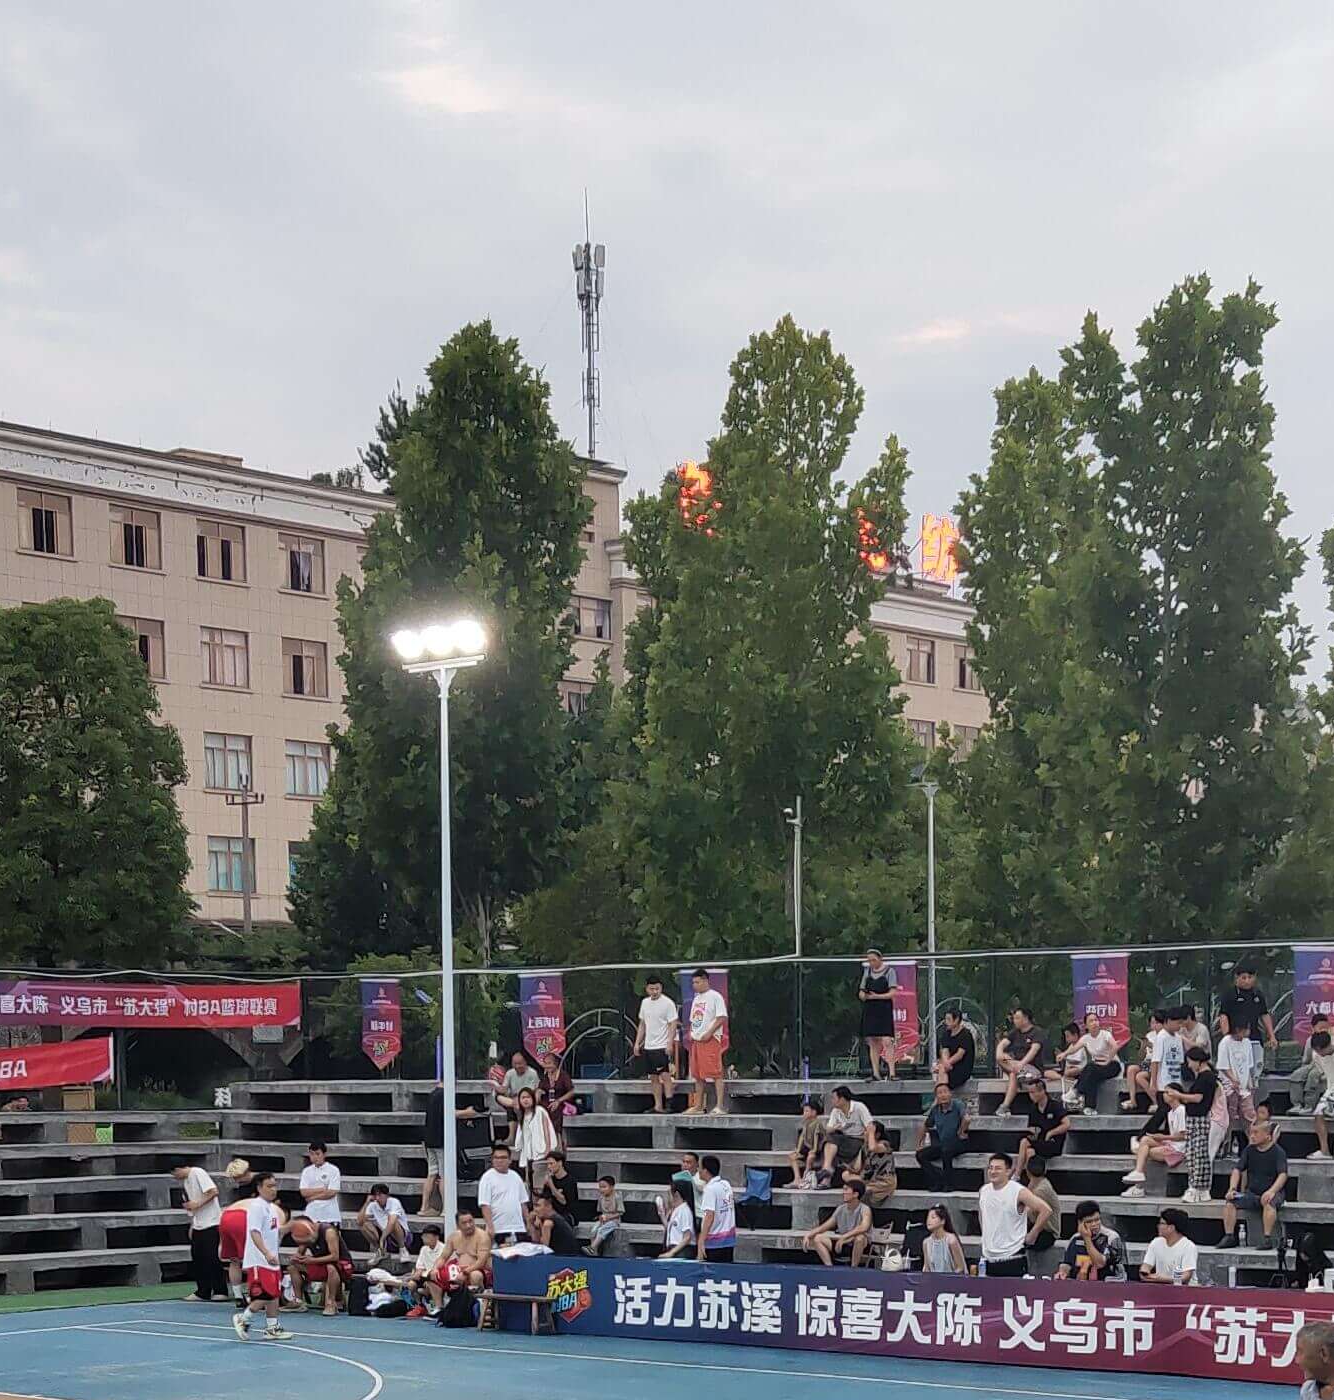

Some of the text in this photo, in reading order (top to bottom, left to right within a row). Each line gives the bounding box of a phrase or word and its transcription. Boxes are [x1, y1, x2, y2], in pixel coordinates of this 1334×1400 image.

[60, 996, 108, 1016] 义乌市
[183, 997, 278, 1017] 村BA篮球联赛
[612, 1273, 782, 1334] 活力苏溪
[794, 1283, 983, 1347] 惊喜大陈
[998, 1294, 1157, 1357] 义乌市
